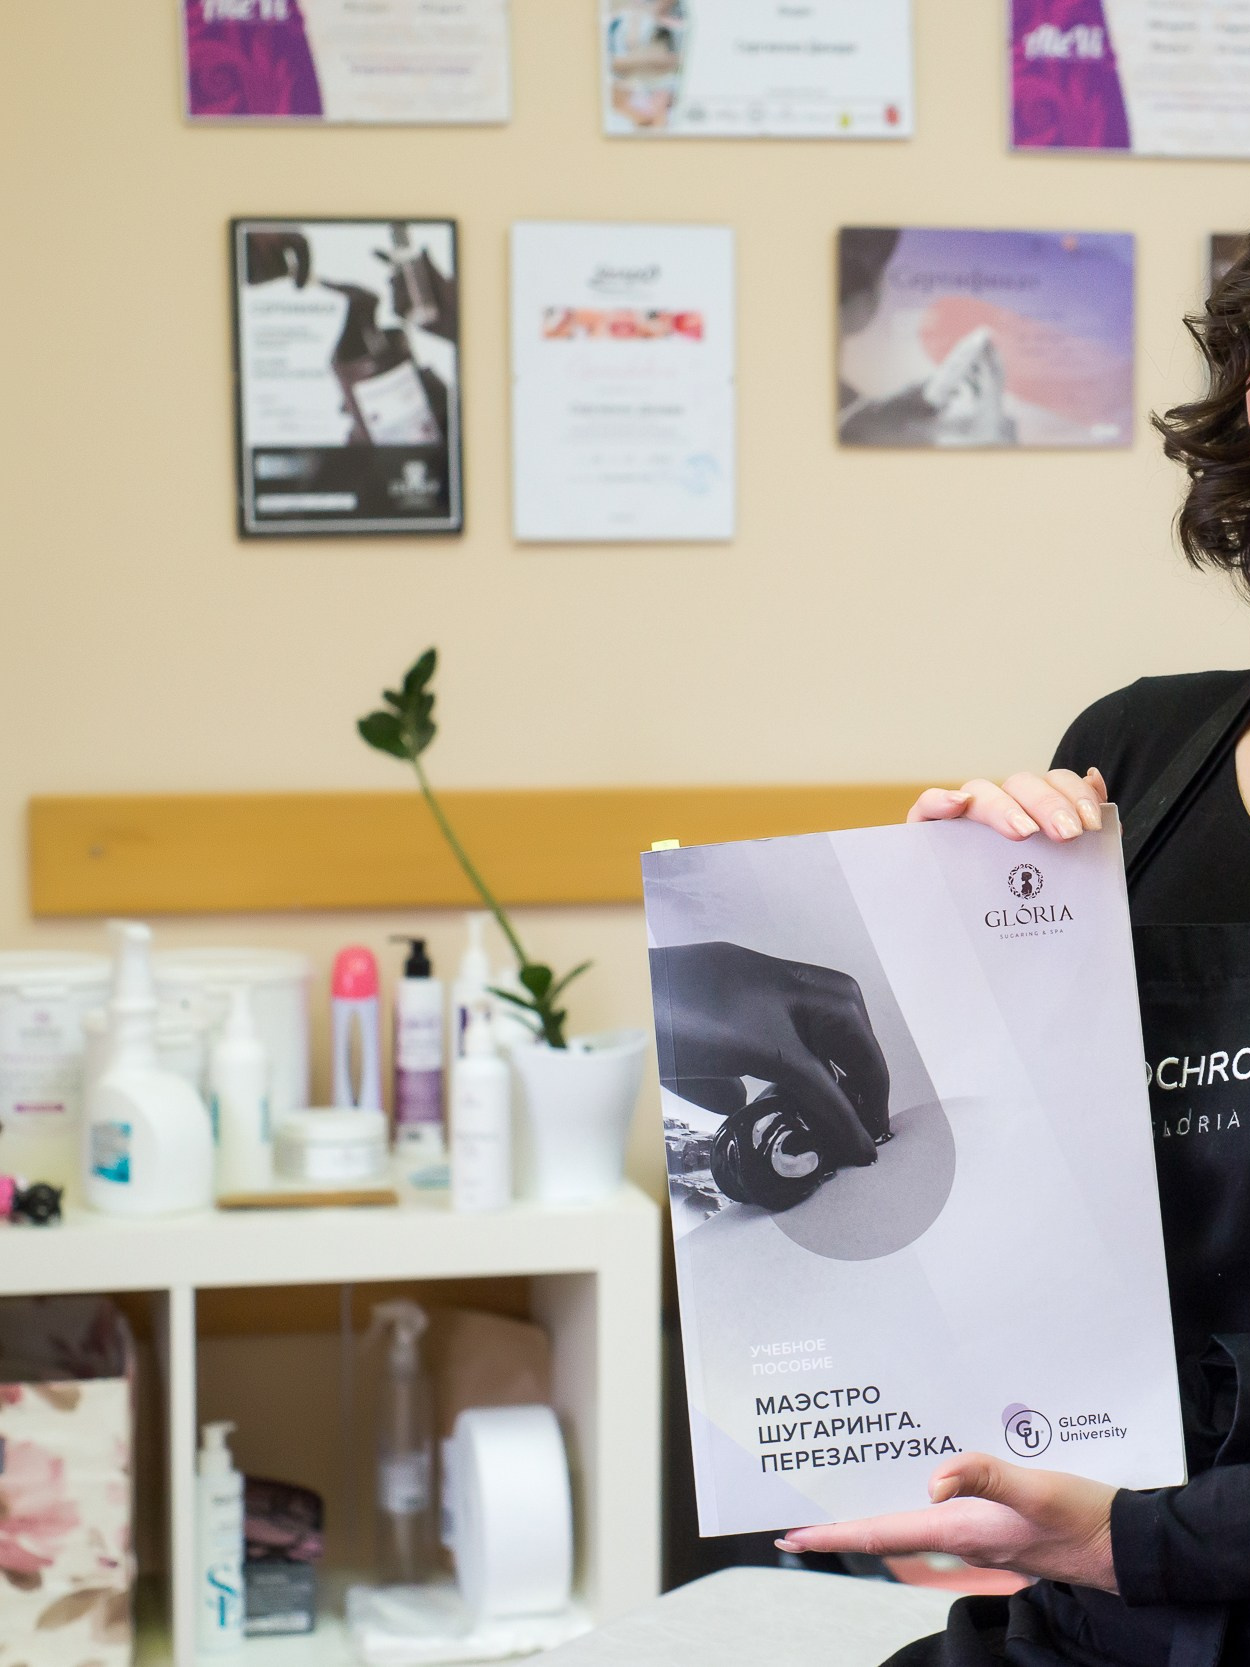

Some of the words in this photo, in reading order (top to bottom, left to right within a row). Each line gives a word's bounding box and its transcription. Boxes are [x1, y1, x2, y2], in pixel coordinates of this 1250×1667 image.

[999, 930, 1039, 940] SUGARING
[750, 1338, 827, 1358] УЧЕБНОЕ
[752, 1356, 833, 1376] ПОСОБИЕ
[755, 1385, 881, 1416] МАЭСТРО
[758, 1411, 921, 1444] ШУГАРИНГА.
[1058, 1412, 1112, 1428] GLORIA
[1060, 1426, 1128, 1442] University
[761, 1435, 963, 1473] ПЕРЕЗАГРУЗКА.
